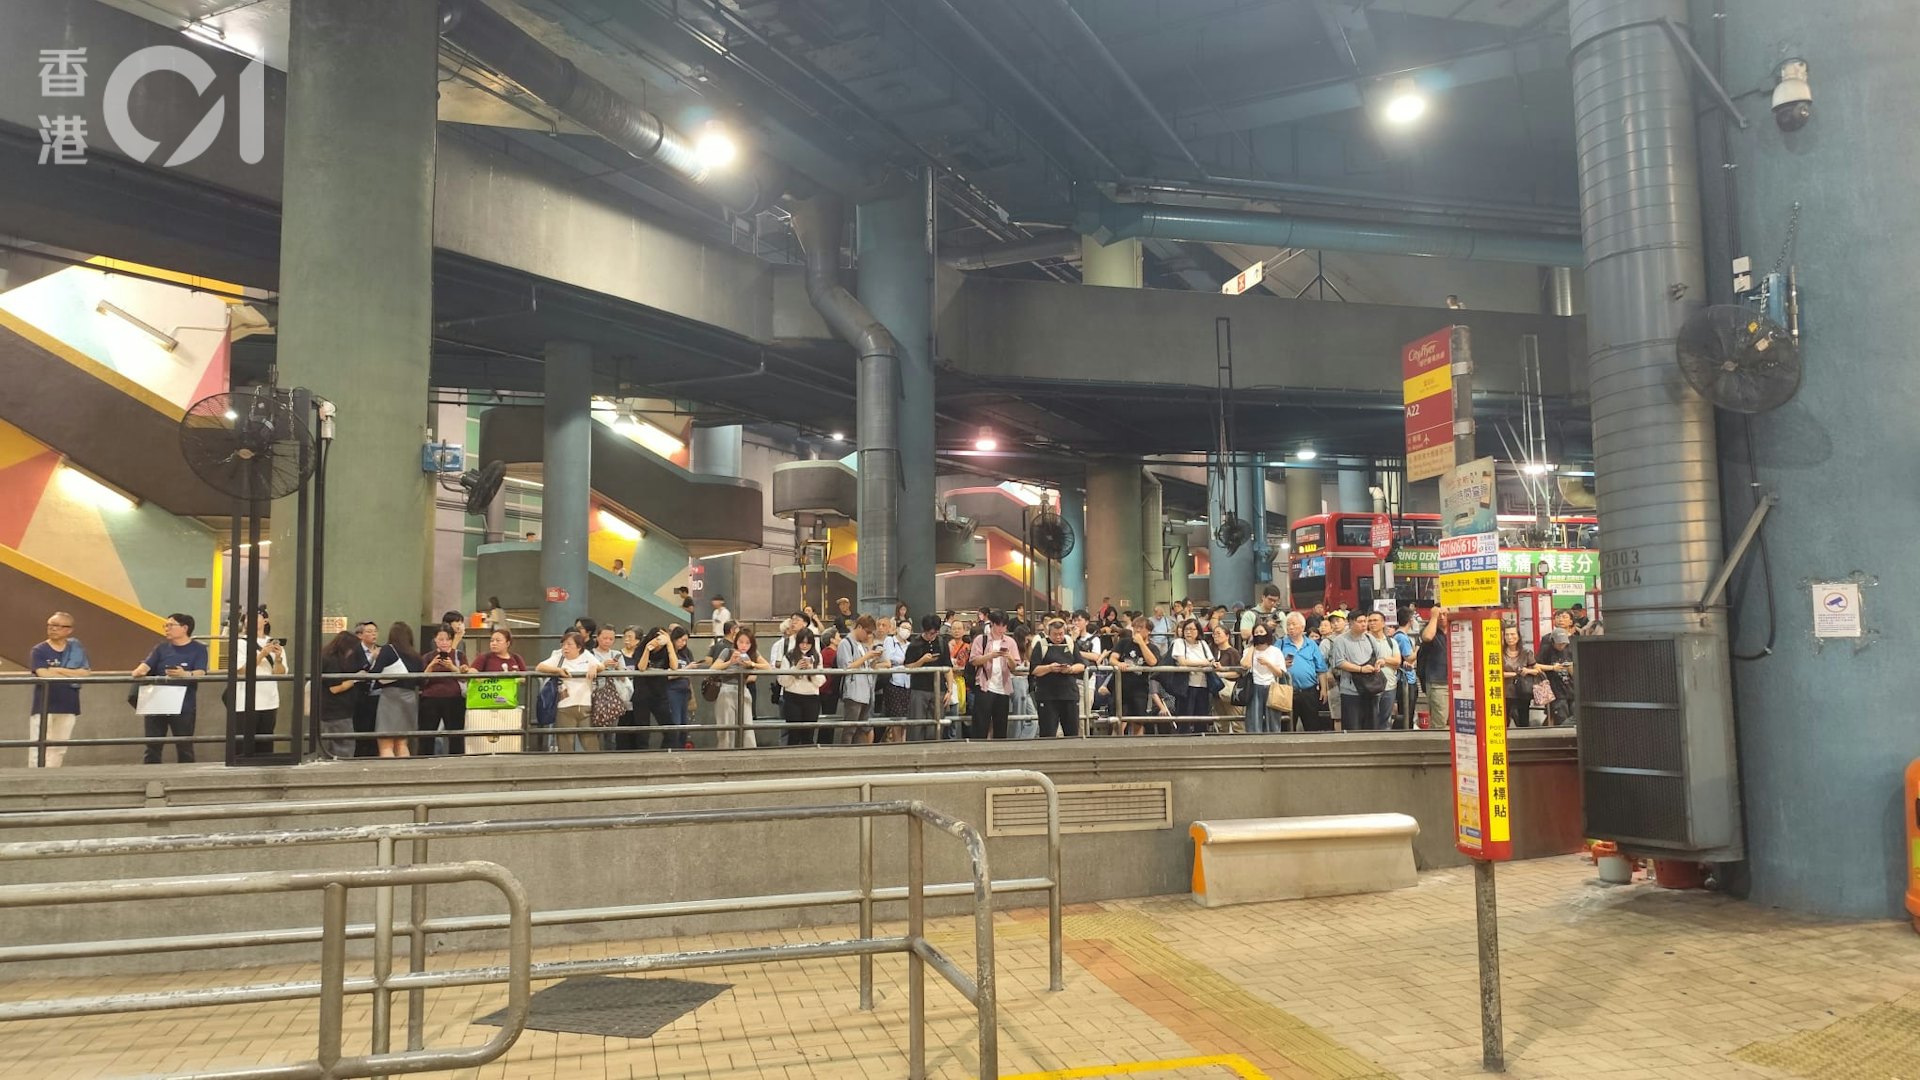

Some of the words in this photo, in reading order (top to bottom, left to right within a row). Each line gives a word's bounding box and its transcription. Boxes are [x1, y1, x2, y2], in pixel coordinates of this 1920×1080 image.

[1406, 404, 1420, 418] A22
[1440, 541, 1450, 557] 601
[1450, 539, 1461, 555] 606
[1461, 537, 1477, 553] 619
[1459, 558, 1471, 571] 18
[478, 685, 503, 693] GO-TO
[1488, 652, 1503, 717] 嚴禁標貼
[1492, 752, 1507, 819] 嚴禁標貼
